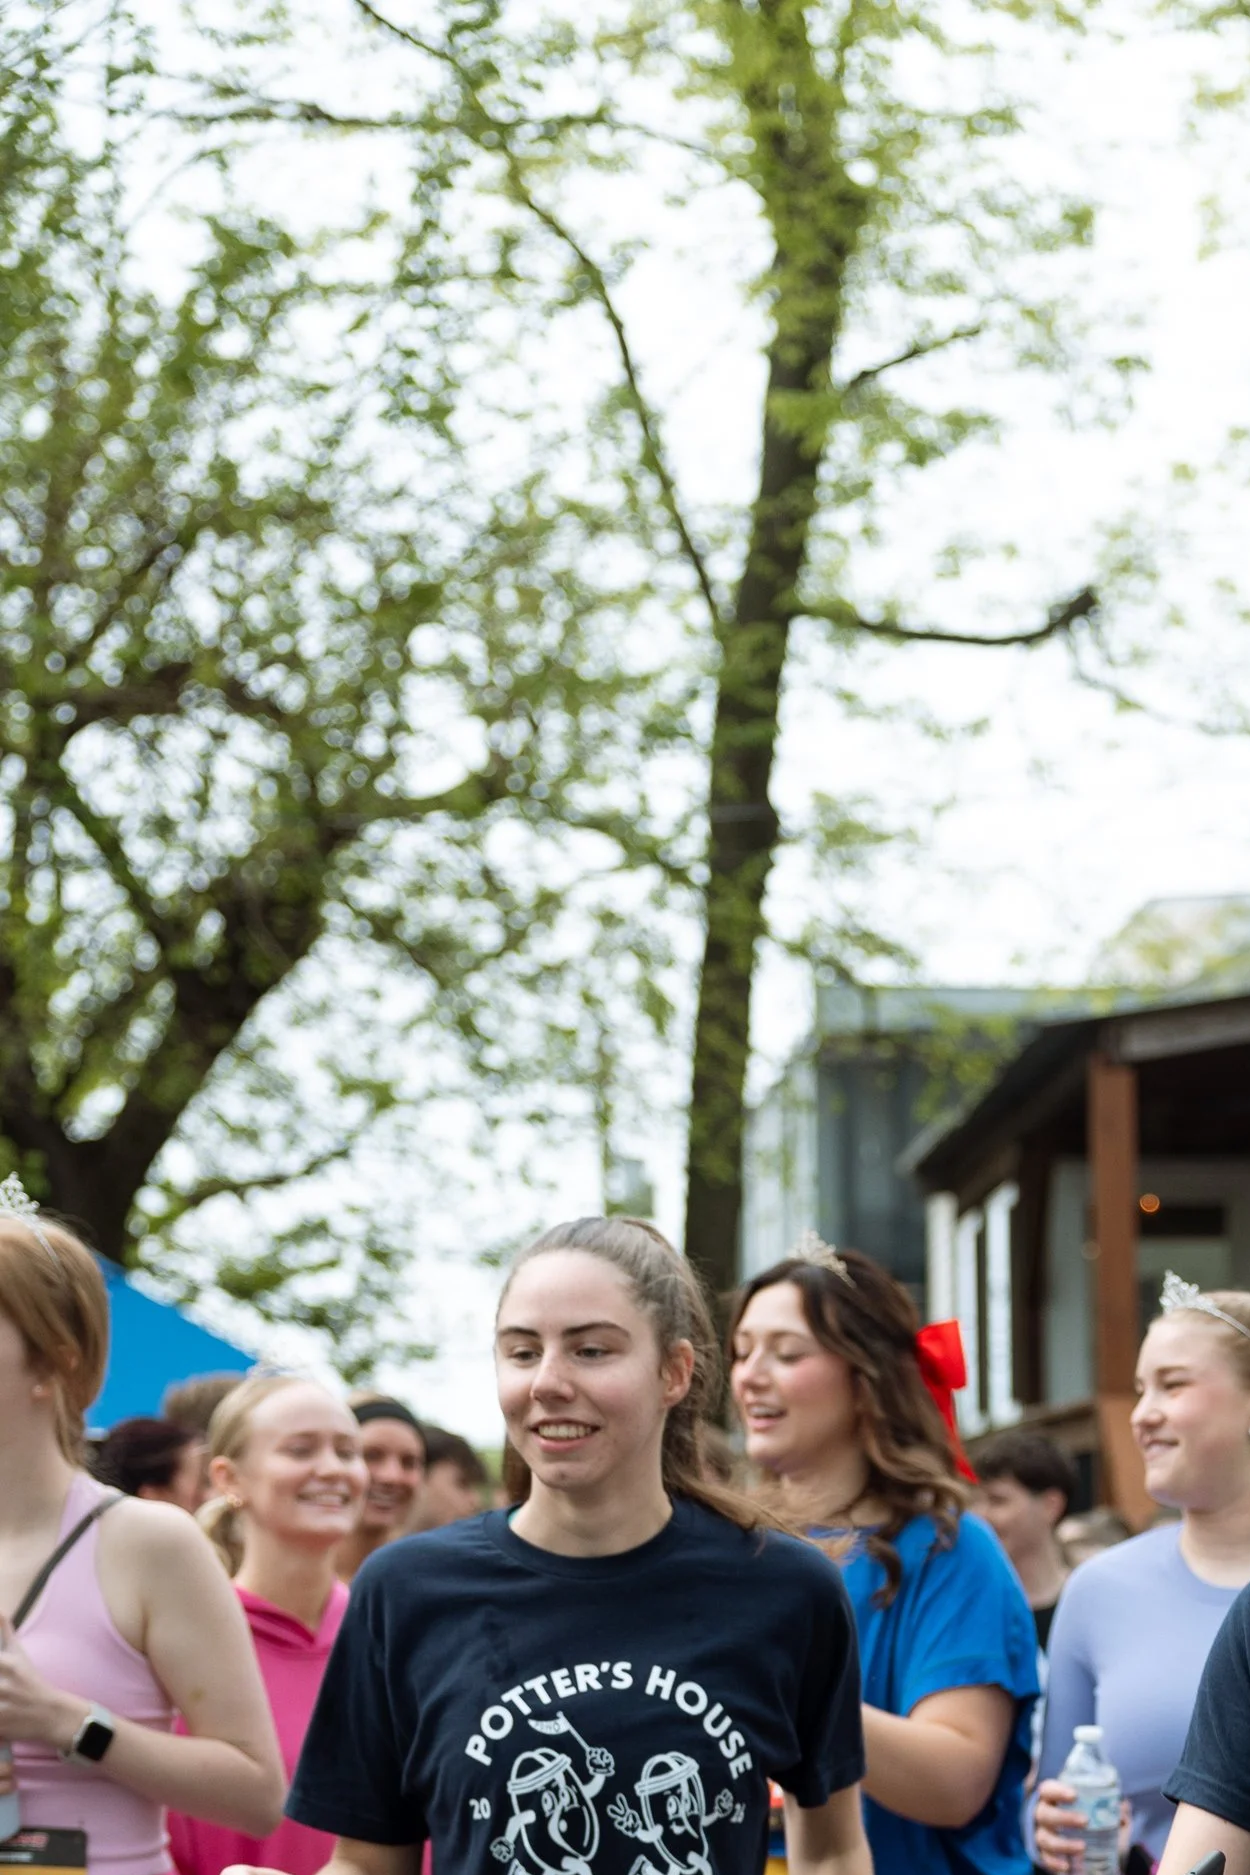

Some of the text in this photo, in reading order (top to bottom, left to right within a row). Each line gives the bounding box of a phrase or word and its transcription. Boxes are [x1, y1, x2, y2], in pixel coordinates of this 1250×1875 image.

[465, 1661, 753, 1780] POTTER'S HOUSE
[469, 1798, 490, 1819] 20
